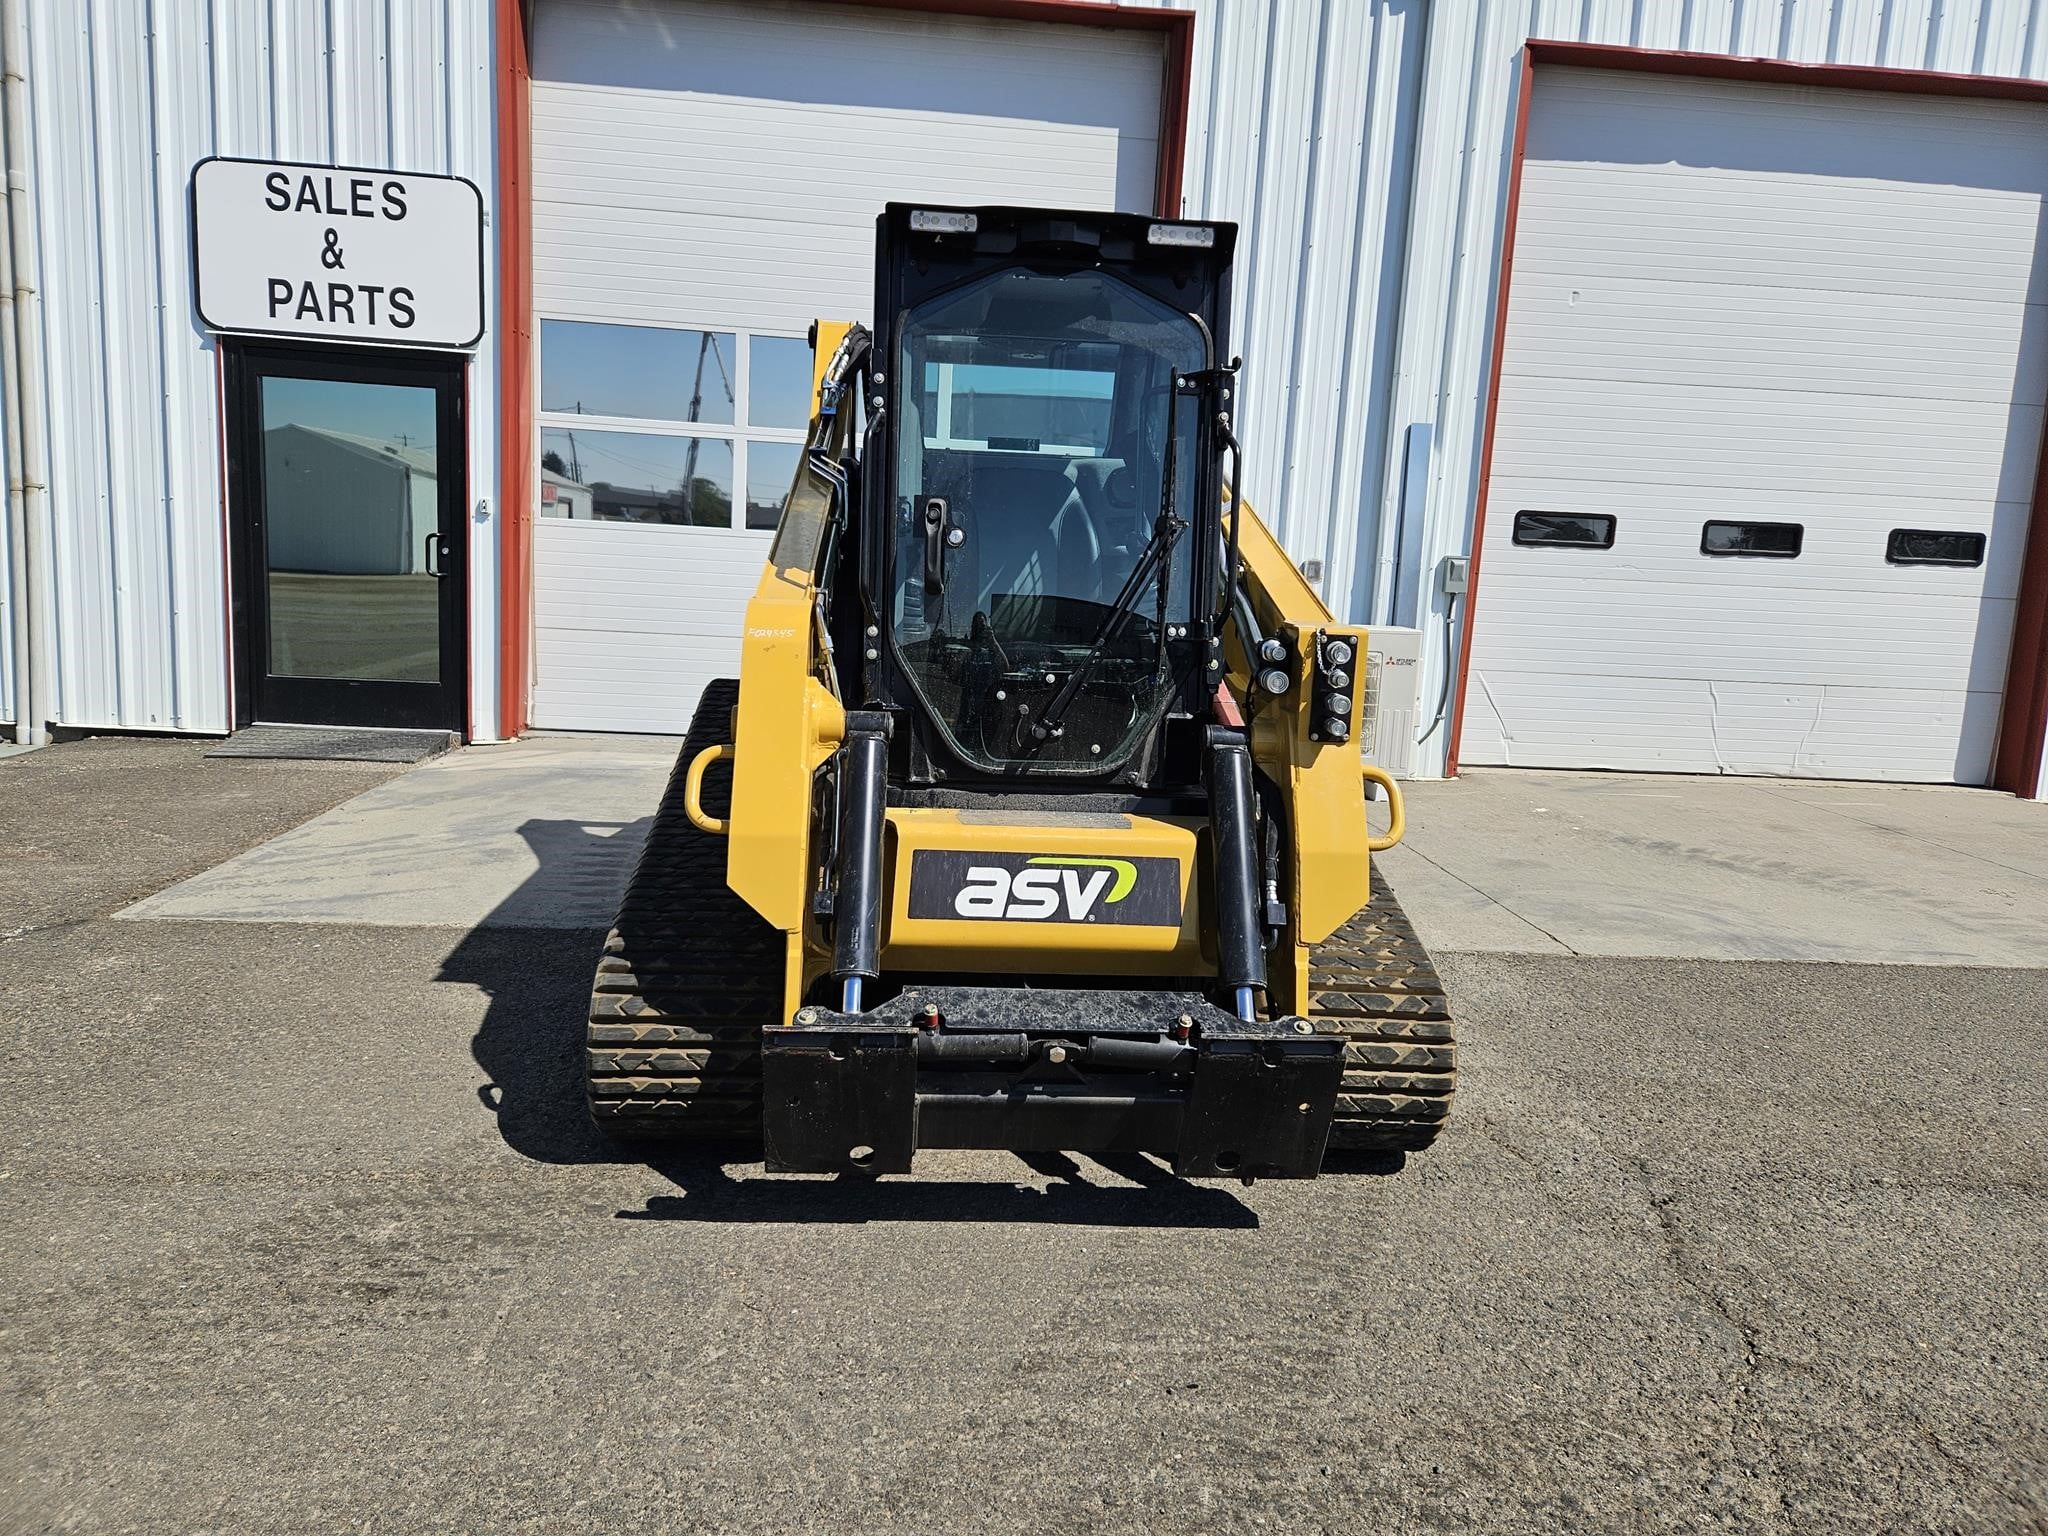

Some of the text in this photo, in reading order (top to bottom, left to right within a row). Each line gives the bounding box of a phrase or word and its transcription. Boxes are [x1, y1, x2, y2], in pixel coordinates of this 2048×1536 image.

[265, 172, 408, 221] SALES
[321, 227, 346, 269] &
[267, 278, 416, 329] PARTS
